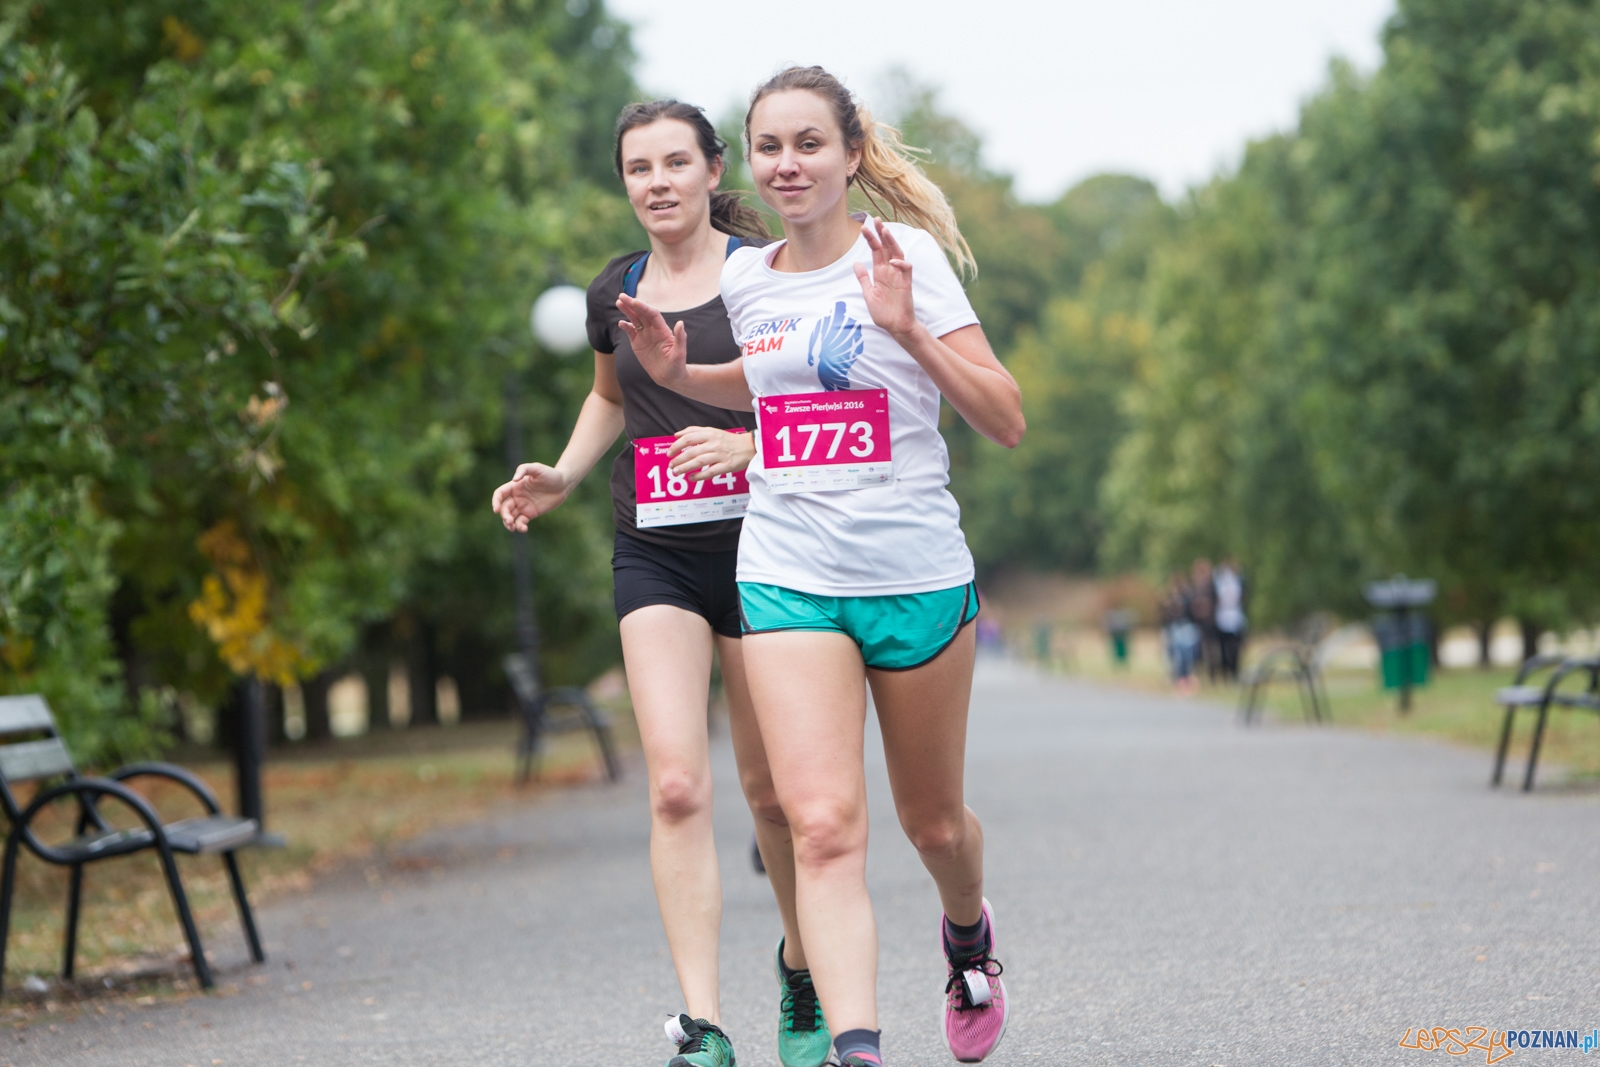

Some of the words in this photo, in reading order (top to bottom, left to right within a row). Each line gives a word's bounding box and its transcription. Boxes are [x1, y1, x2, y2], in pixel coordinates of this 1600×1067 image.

[745, 318, 802, 340] ERNIK
[785, 404, 811, 413] Zawsze
[811, 402, 842, 412] Pier(w)si
[844, 401, 864, 409] 2016
[775, 421, 875, 462] 1773
